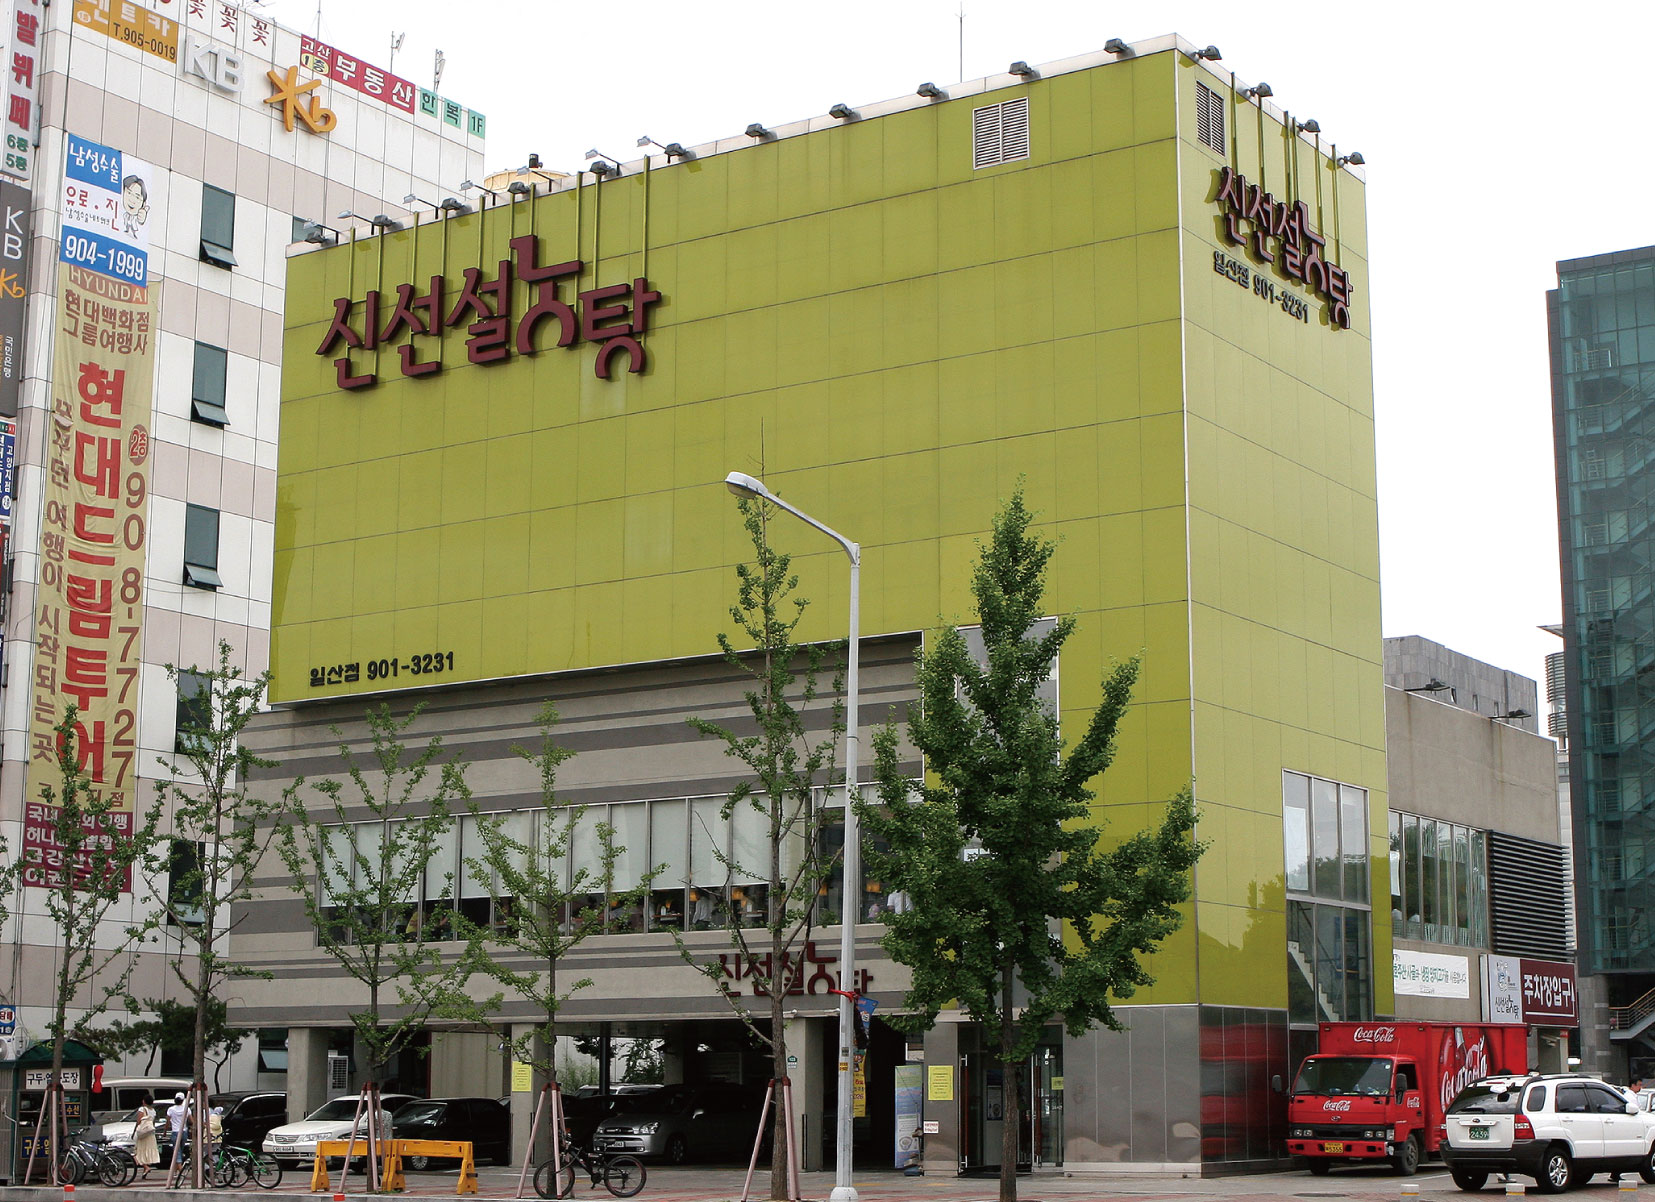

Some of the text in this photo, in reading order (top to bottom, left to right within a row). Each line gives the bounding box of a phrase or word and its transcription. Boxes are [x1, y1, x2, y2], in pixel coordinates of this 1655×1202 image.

[113, 22, 176, 60] T.905-0019
[220, 4, 238, 33] 꽃
[252, 18, 270, 46] 꽃
[9, 0, 39, 132] 발뷔페
[184, 34, 246, 93] KB
[302, 37, 413, 108] 고산 부동산
[421, 92, 483, 134] 한복 1F
[5, 153, 28, 172] 5층
[6, 134, 29, 153] 6층
[69, 142, 119, 184] 남성수술
[4, 206, 25, 260] KB
[1214, 166, 1354, 329] 신선설농탕
[65, 235, 145, 281] 904-1999
[70, 264, 147, 303] HYUNDAI
[1213, 250, 1310, 324] 일산점 901-3231
[62, 311, 148, 356] 그룹여행사
[65, 288, 150, 333] 현대백화점
[315, 234, 662, 389] 신선설농탕
[42, 500, 67, 593] 여행이
[56, 361, 125, 784] 현대드림투어
[112, 472, 146, 788] 908-7727
[34, 604, 60, 725] 시작되는
[310, 651, 454, 687] 일산점 901-3231
[33, 732, 54, 764] 곳
